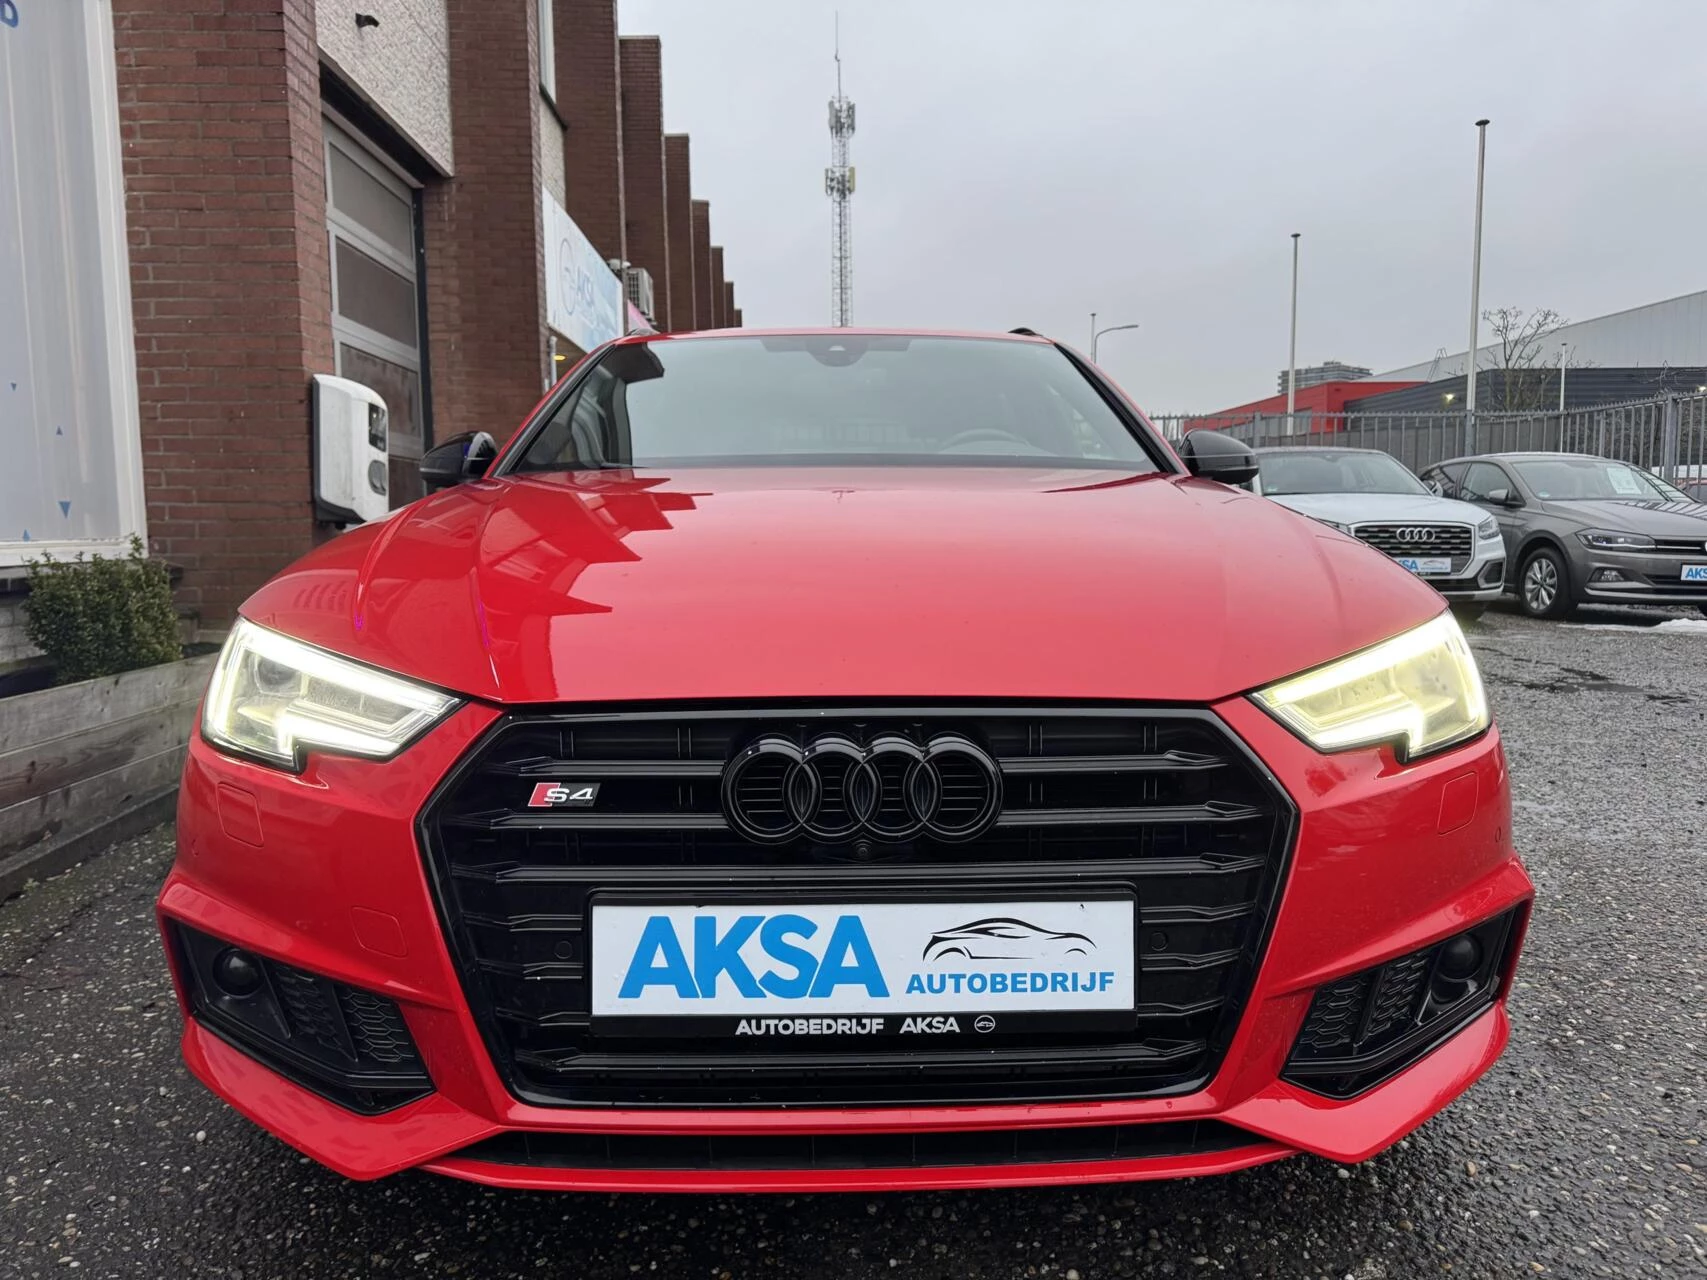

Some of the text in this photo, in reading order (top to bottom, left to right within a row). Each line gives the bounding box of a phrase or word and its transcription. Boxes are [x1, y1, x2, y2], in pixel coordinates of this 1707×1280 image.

[1684, 567, 1707, 579] AKS
[543, 787, 594, 802] S4
[618, 914, 890, 999] AKSA
[905, 971, 1115, 995] AUTOBEDRIJF
[735, 1016, 961, 1035] AUTOBEDRIJF AKSA
